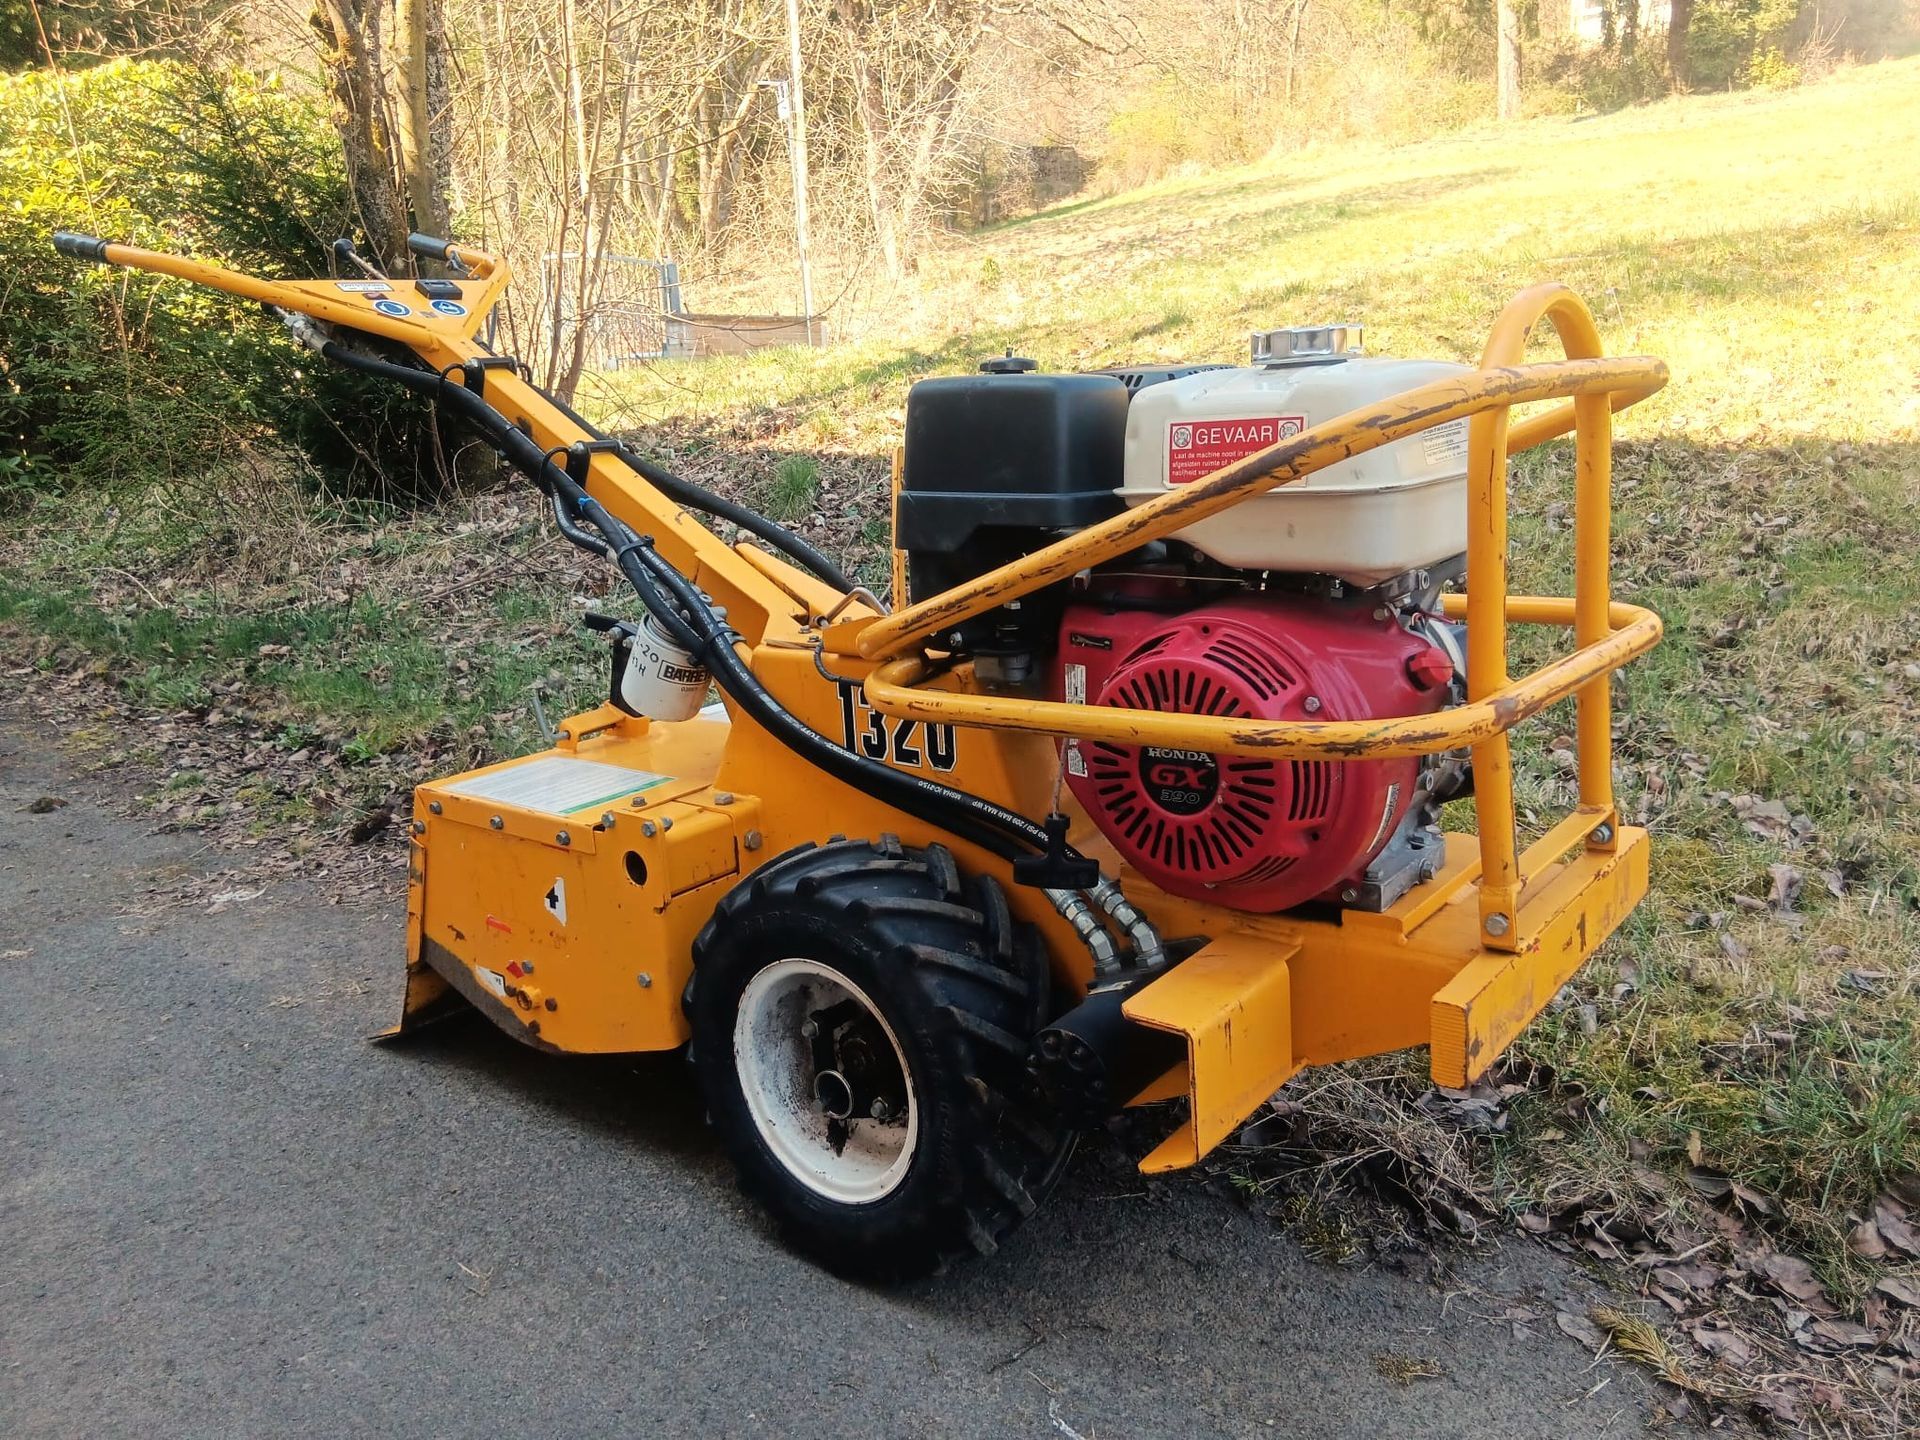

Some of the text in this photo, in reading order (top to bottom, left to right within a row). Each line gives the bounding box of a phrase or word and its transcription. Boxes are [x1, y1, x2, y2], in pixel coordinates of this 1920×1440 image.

[1195, 425, 1273, 445] GEVAAR
[1147, 747, 1212, 763] HONDA
[1151, 764, 1209, 790] GX
[1160, 788, 1200, 804] 390
[985, 804, 1000, 816] MAX
[998, 811, 1013, 822] BAR
